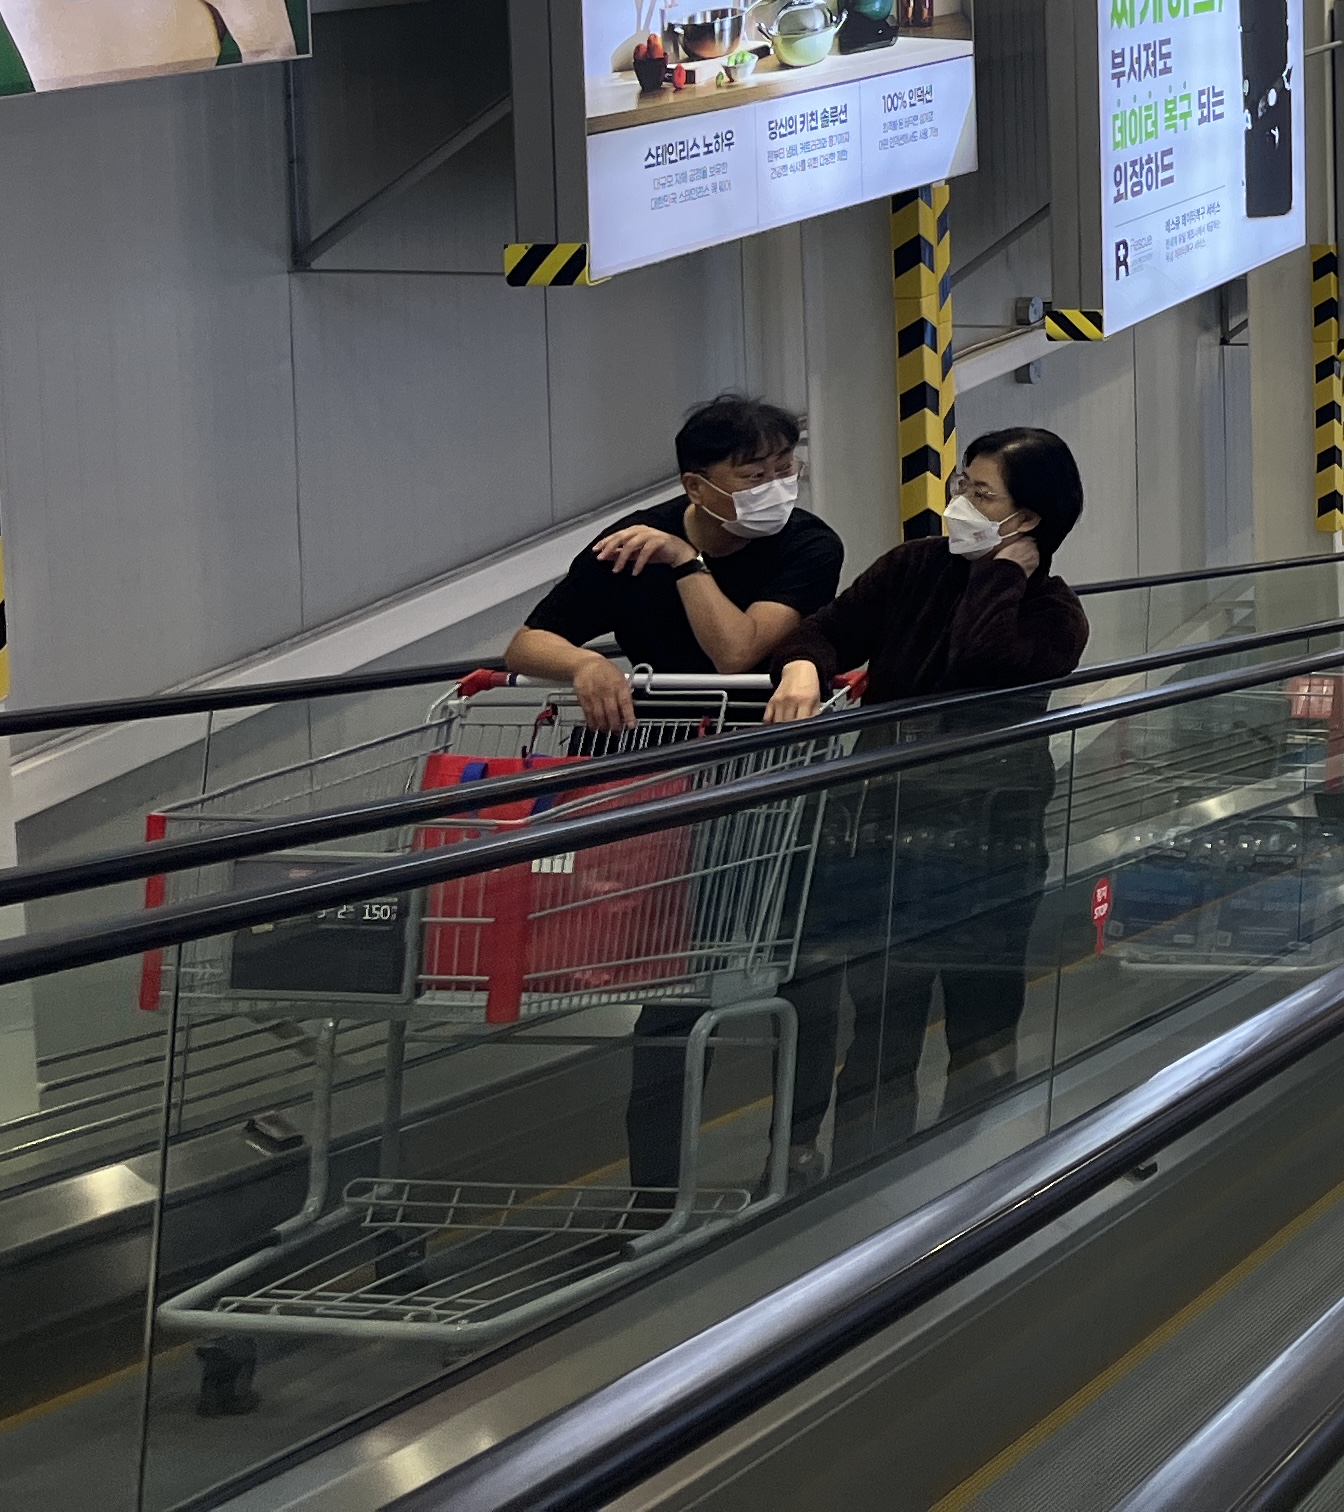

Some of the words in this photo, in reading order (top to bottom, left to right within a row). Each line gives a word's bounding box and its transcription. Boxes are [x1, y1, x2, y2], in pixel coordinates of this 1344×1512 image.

[1111, 37, 1173, 88] 부서져도
[768, 115, 798, 140] 당신의
[799, 109, 819, 134] 키친
[820, 103, 848, 129] 솔루션
[882, 90, 907, 114] 100%
[908, 84, 933, 108] 인덕션
[1112, 100, 1159, 151] 데이터
[1164, 92, 1193, 134] 복구
[1198, 85, 1225, 126] 되는
[644, 137, 701, 169] 스테인리스
[702, 129, 735, 156] 노하우
[1113, 147, 1175, 204] 외장하드
